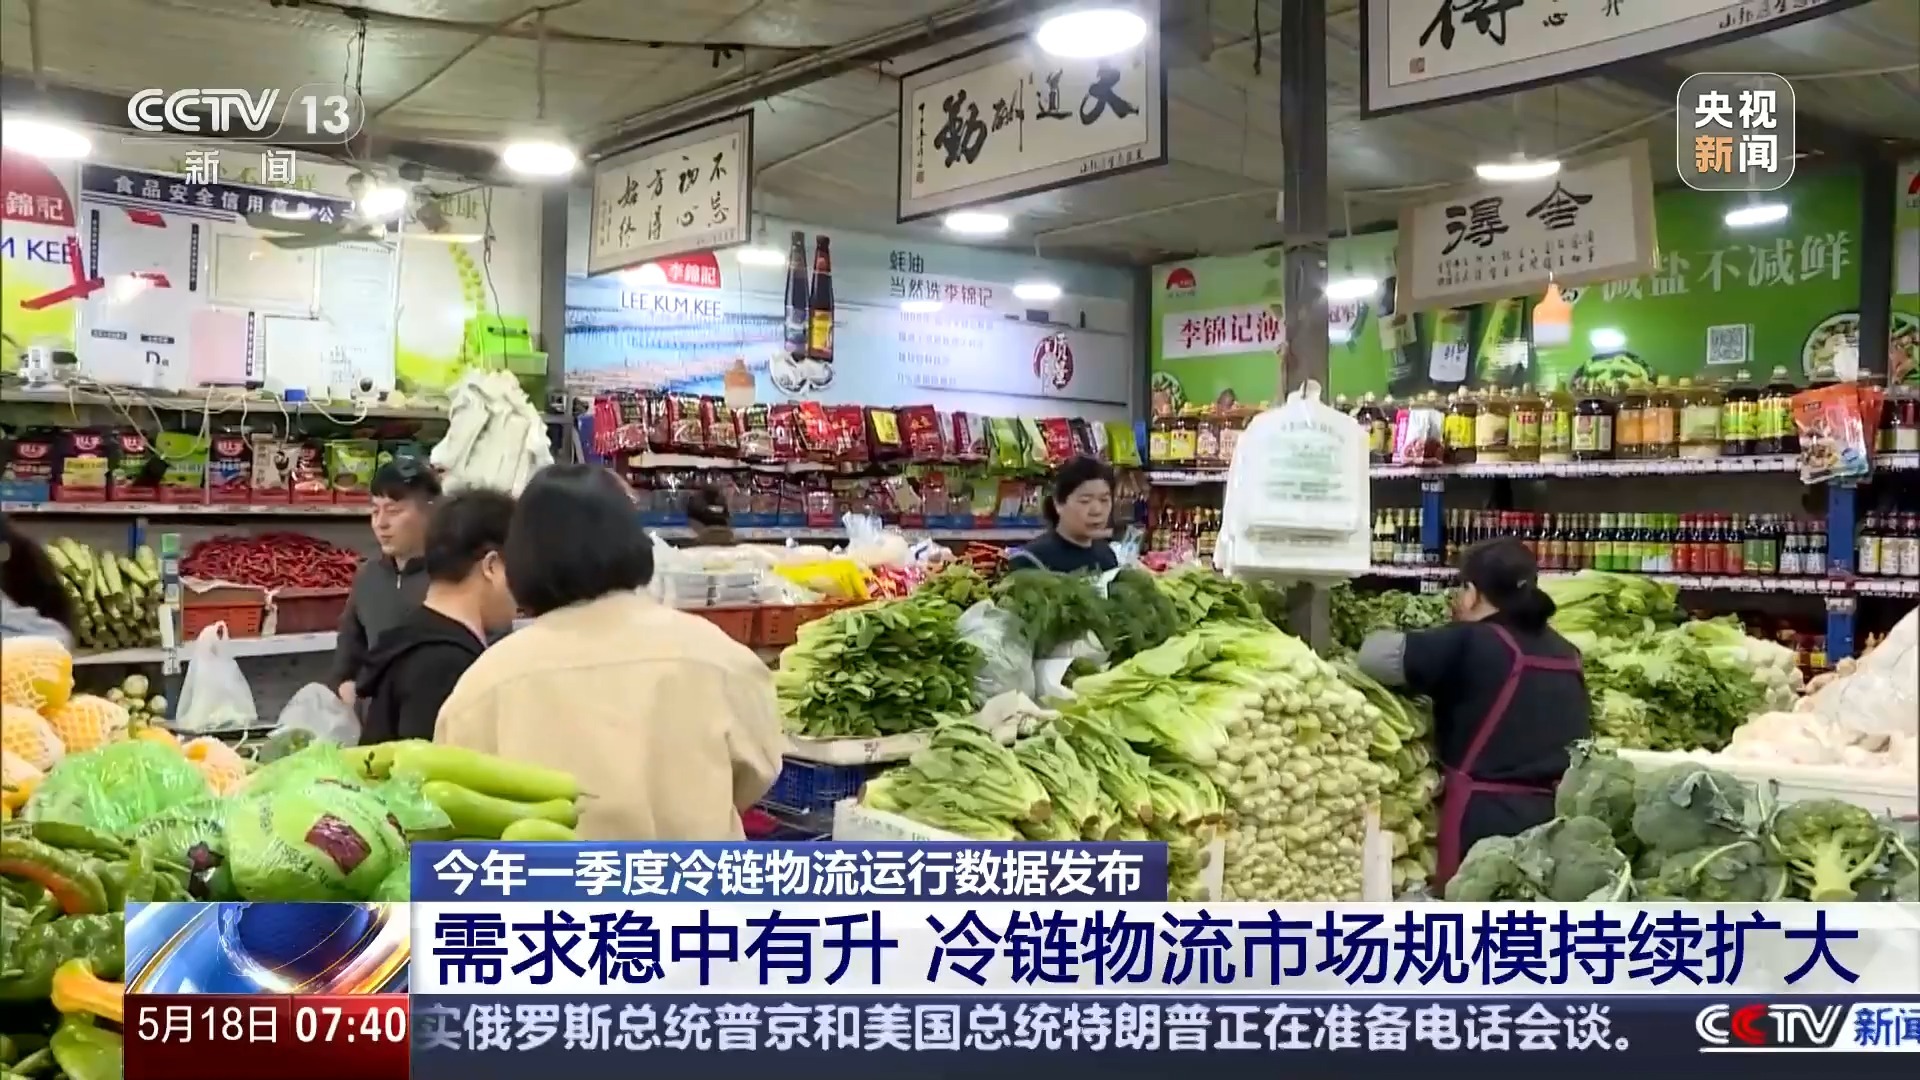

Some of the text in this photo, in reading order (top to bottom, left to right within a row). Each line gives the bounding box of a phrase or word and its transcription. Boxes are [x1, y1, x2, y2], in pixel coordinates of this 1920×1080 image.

[889, 250, 924, 273] 蚝油
[621, 291, 721, 319] LEE KUM KEE
[890, 276, 993, 309] 当然选李锦记
